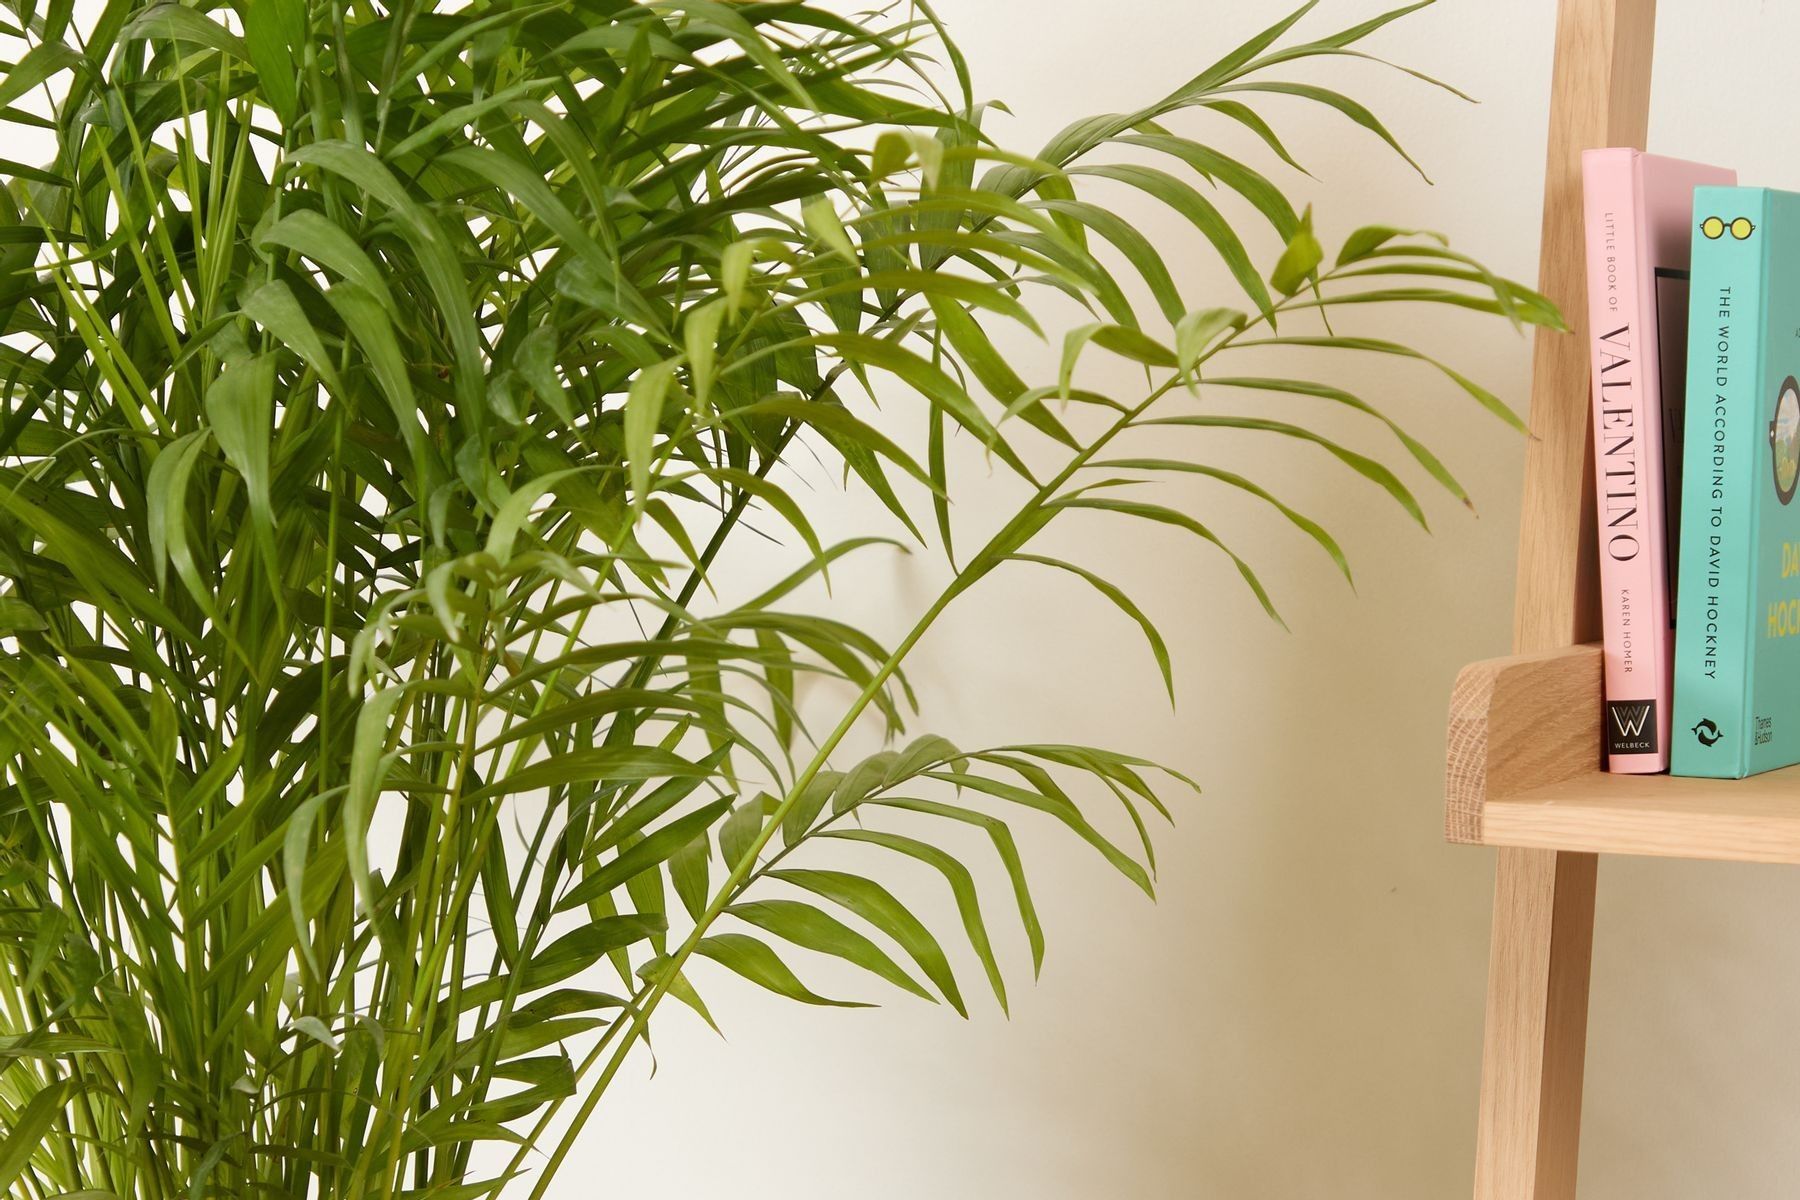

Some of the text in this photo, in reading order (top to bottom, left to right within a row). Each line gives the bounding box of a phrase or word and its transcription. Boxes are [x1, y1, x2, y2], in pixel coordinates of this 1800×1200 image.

[1604, 212, 1618, 312] LITTLE BOOK OF
[1599, 322, 1640, 561] VALENTINO
[1704, 286, 1731, 680] THE WORLD ACCORDING TO DAVID HOCKNEY
[1782, 543, 1800, 578] DA
[1621, 589, 1633, 673] KAREN HOMER
